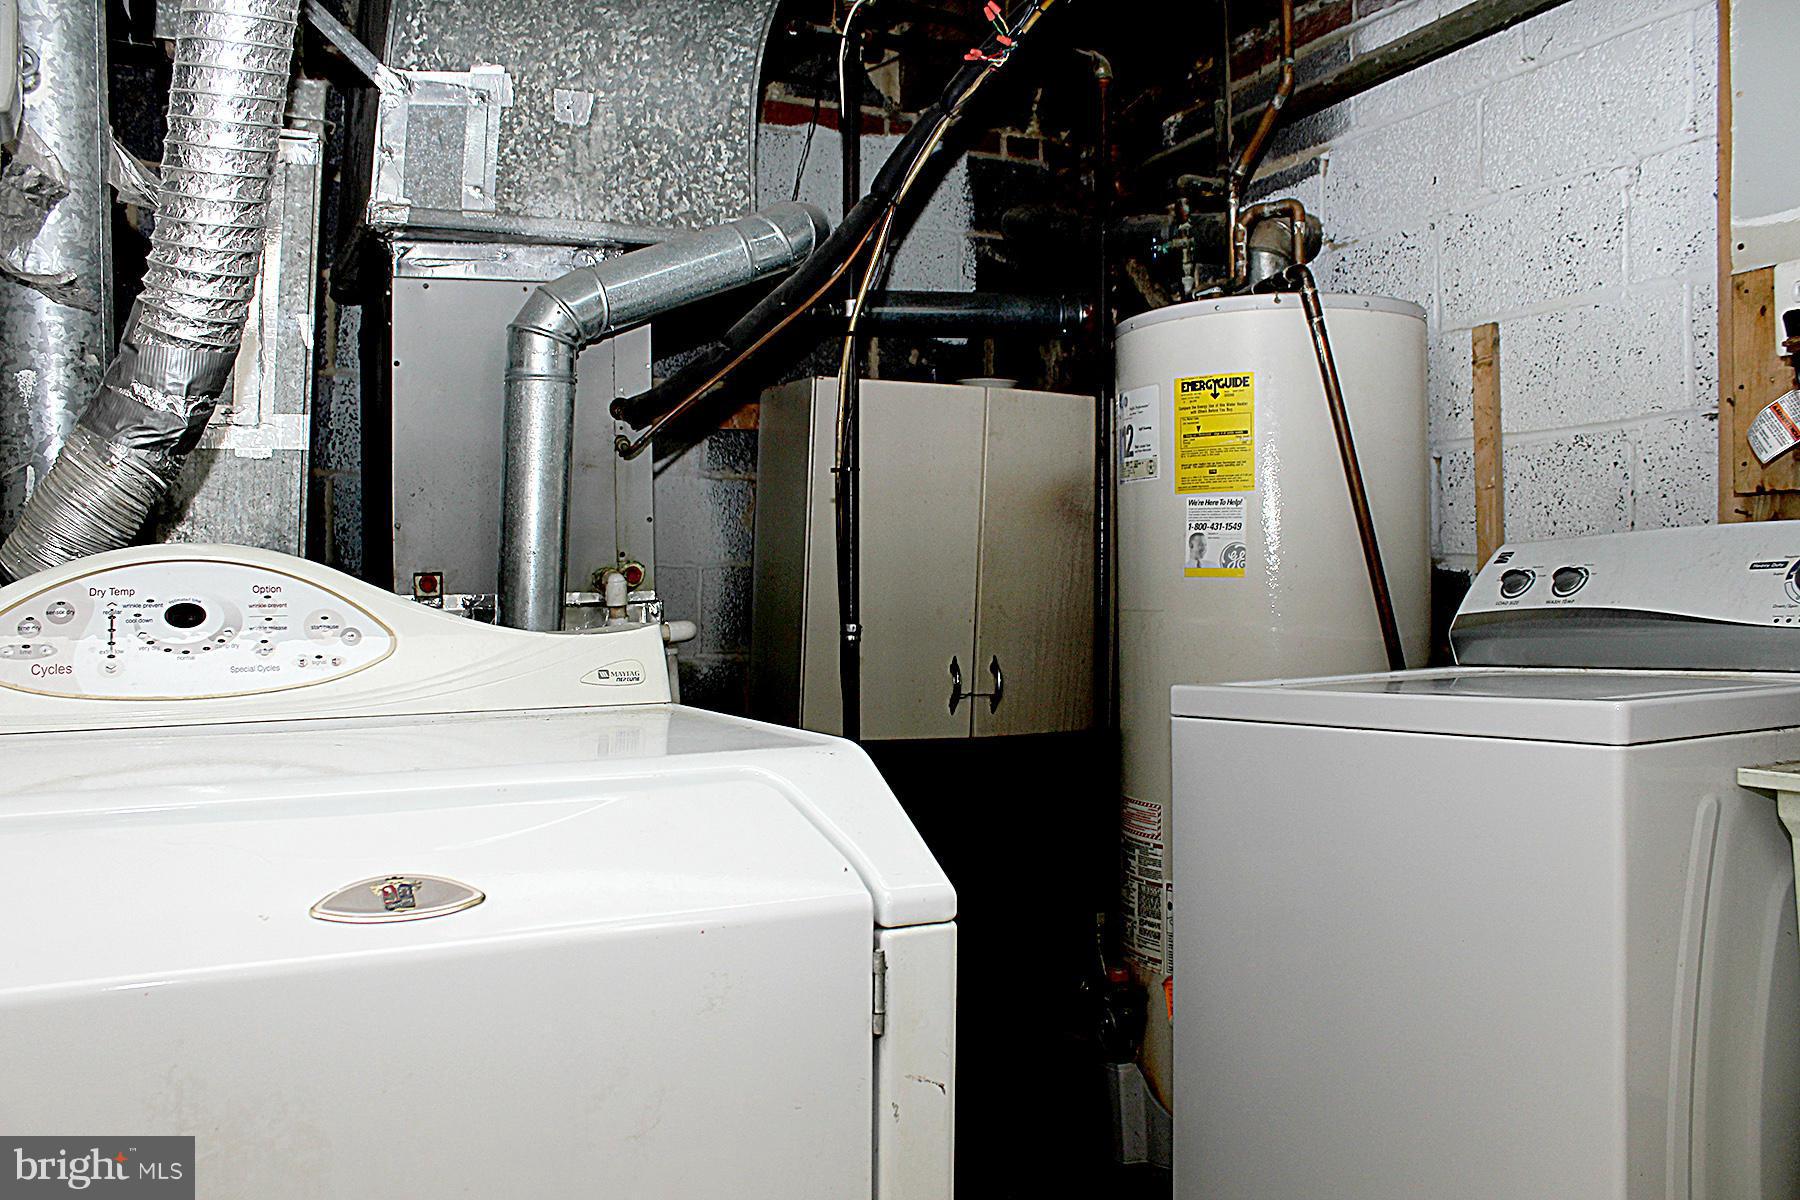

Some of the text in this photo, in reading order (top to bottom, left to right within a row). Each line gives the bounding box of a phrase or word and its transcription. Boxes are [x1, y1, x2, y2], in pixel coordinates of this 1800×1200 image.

[1219, 498, 1227, 506] To
[1227, 498, 1243, 507] Help!
[1188, 522, 1243, 531] 1-800-431-1549
[89, 587, 136, 599] Dry Temp
[252, 585, 282, 594] Option
[30, 663, 73, 678] Cycles
[230, 664, 281, 673] Special Cycles
